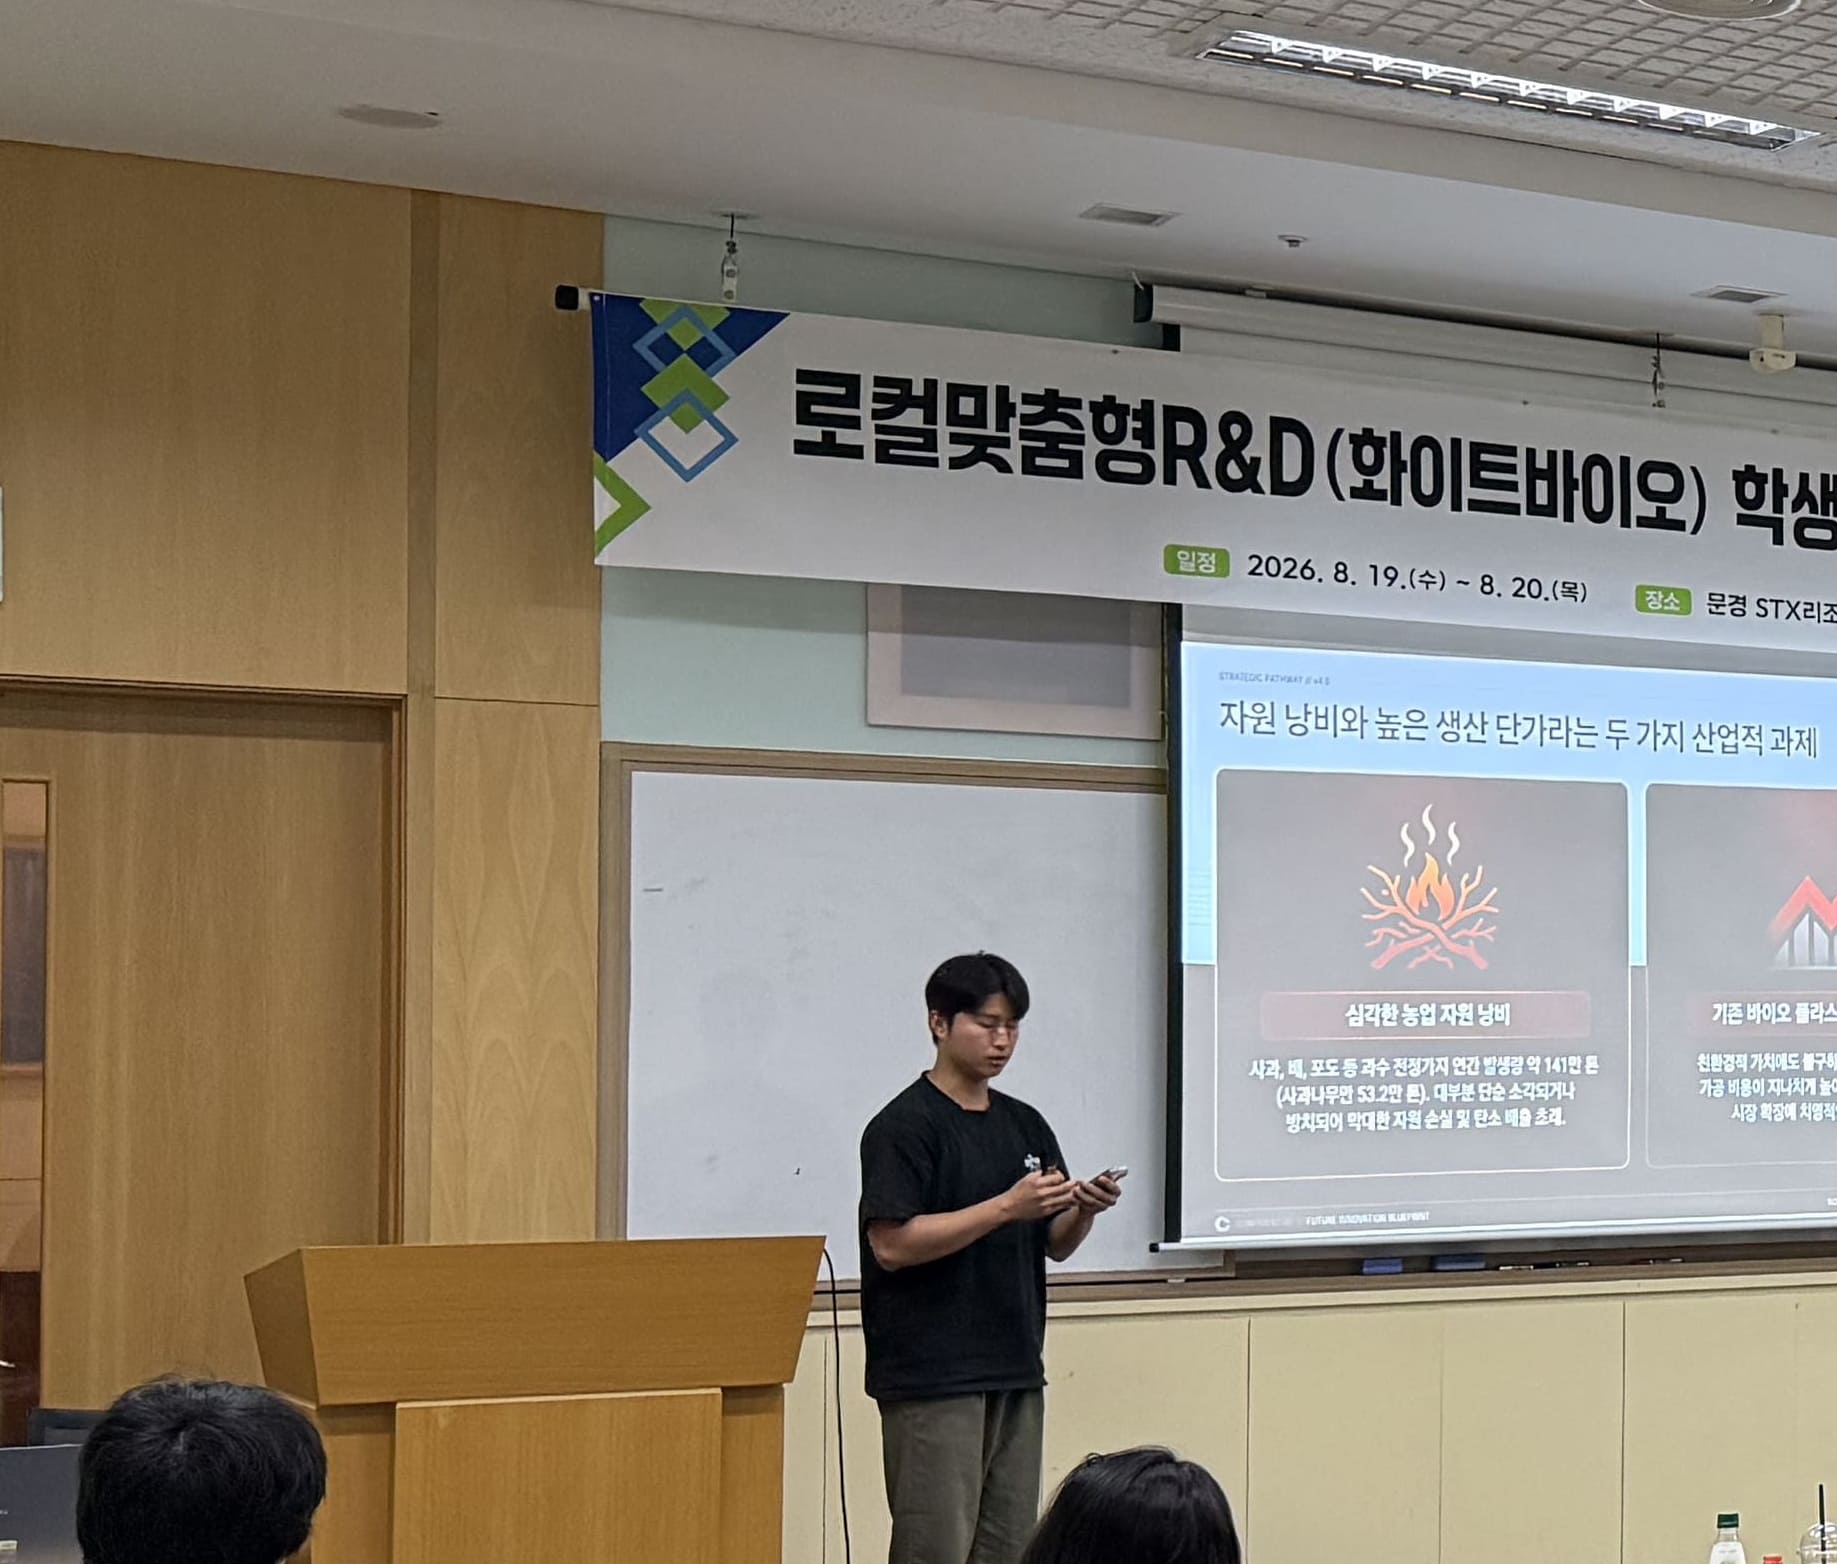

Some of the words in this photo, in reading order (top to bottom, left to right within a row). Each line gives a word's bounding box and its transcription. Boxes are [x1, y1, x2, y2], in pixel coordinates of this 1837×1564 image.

[1176, 549, 1218, 573] 일정
[1246, 553, 1324, 584] 2026.
[1333, 561, 1357, 587] 8.
[1368, 563, 1447, 592] 19.(수)
[1479, 573, 1502, 598] 8.
[1511, 576, 1588, 603] 20.(목)
[1644, 589, 1681, 613] 장소
[1706, 591, 1748, 617] 문경
[1219, 699, 1277, 735] 자원
[1284, 702, 1369, 740] 낭비와
[1374, 706, 1430, 742] 높은
[1435, 709, 1489, 744] 생산
[1496, 712, 1599, 749] 단가라는
[1605, 719, 1631, 751] 두
[1635, 719, 1685, 753] 가지
[1691, 721, 1764, 757] 산업적
[1769, 724, 1818, 759] 과제
[1345, 1003, 1399, 1027] 심각한
[1402, 1003, 1437, 1027] 농업
[1439, 1003, 1475, 1027] 자원
[1477, 1003, 1512, 1027] 낭비
[1711, 1002, 1743, 1025] 기존
[1746, 1002, 1792, 1025] 바이오
[1249, 1058, 1285, 1080] 사과,
[1288, 1058, 1308, 1080] 배,
[1310, 1058, 1340, 1077] 포도
[1342, 1057, 1359, 1078] 등
[1361, 1057, 1391, 1078] 과수
[1393, 1056, 1449, 1078] 전정가지
[1452, 1056, 1480, 1077] 연간
[1483, 1055, 1524, 1076] 발생량
[1526, 1055, 1541, 1075] 약
[1544, 1055, 1582, 1075] 141만
[1276, 1084, 1354, 1108] (사과나무만
[1357, 1083, 1403, 1104] 53.2만
[1433, 1082, 1475, 1102] 대부분
[1478, 1082, 1506, 1102] 단순
[1508, 1081, 1576, 1101] 소각되거나
[1285, 1111, 1344, 1133] 방치되어
[1347, 1110, 1391, 1131] 막대한
[1393, 1110, 1422, 1130] 자원
[1424, 1108, 1453, 1130] 손실
[1455, 1109, 1471, 1129] 및
[1473, 1108, 1503, 1128] 탄소
[1504, 1107, 1532, 1128] 배출
